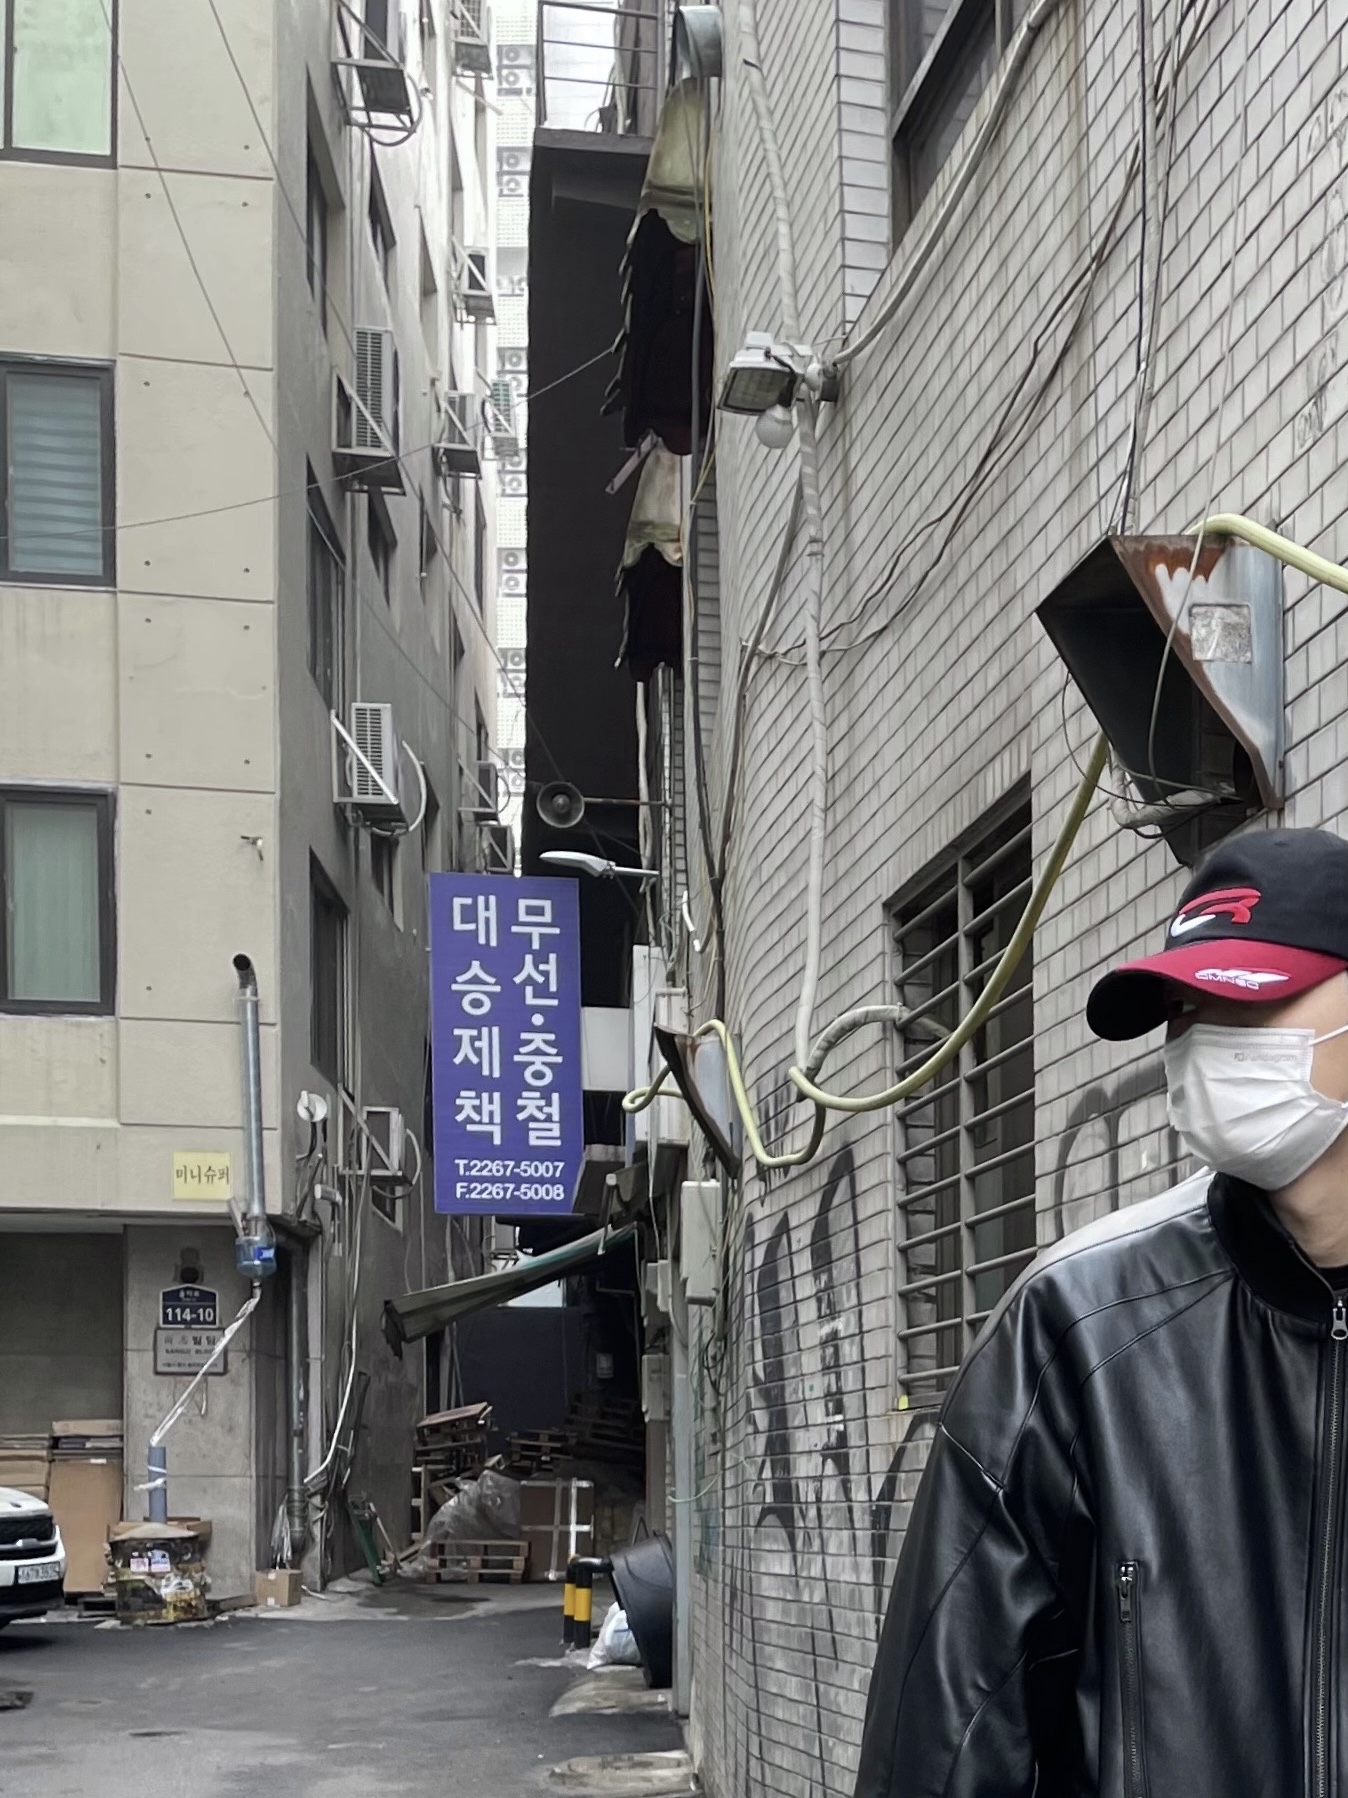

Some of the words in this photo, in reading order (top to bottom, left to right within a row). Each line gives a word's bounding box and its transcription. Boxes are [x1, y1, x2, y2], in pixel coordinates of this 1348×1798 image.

[451, 895, 502, 1146] 대승제책
[175, 1164, 230, 1185] 미니슈퍼
[455, 1159, 565, 1179] T.2267-5007
[456, 1182, 565, 1201] F.2267-5008
[166, 1307, 214, 1322] 114-10
